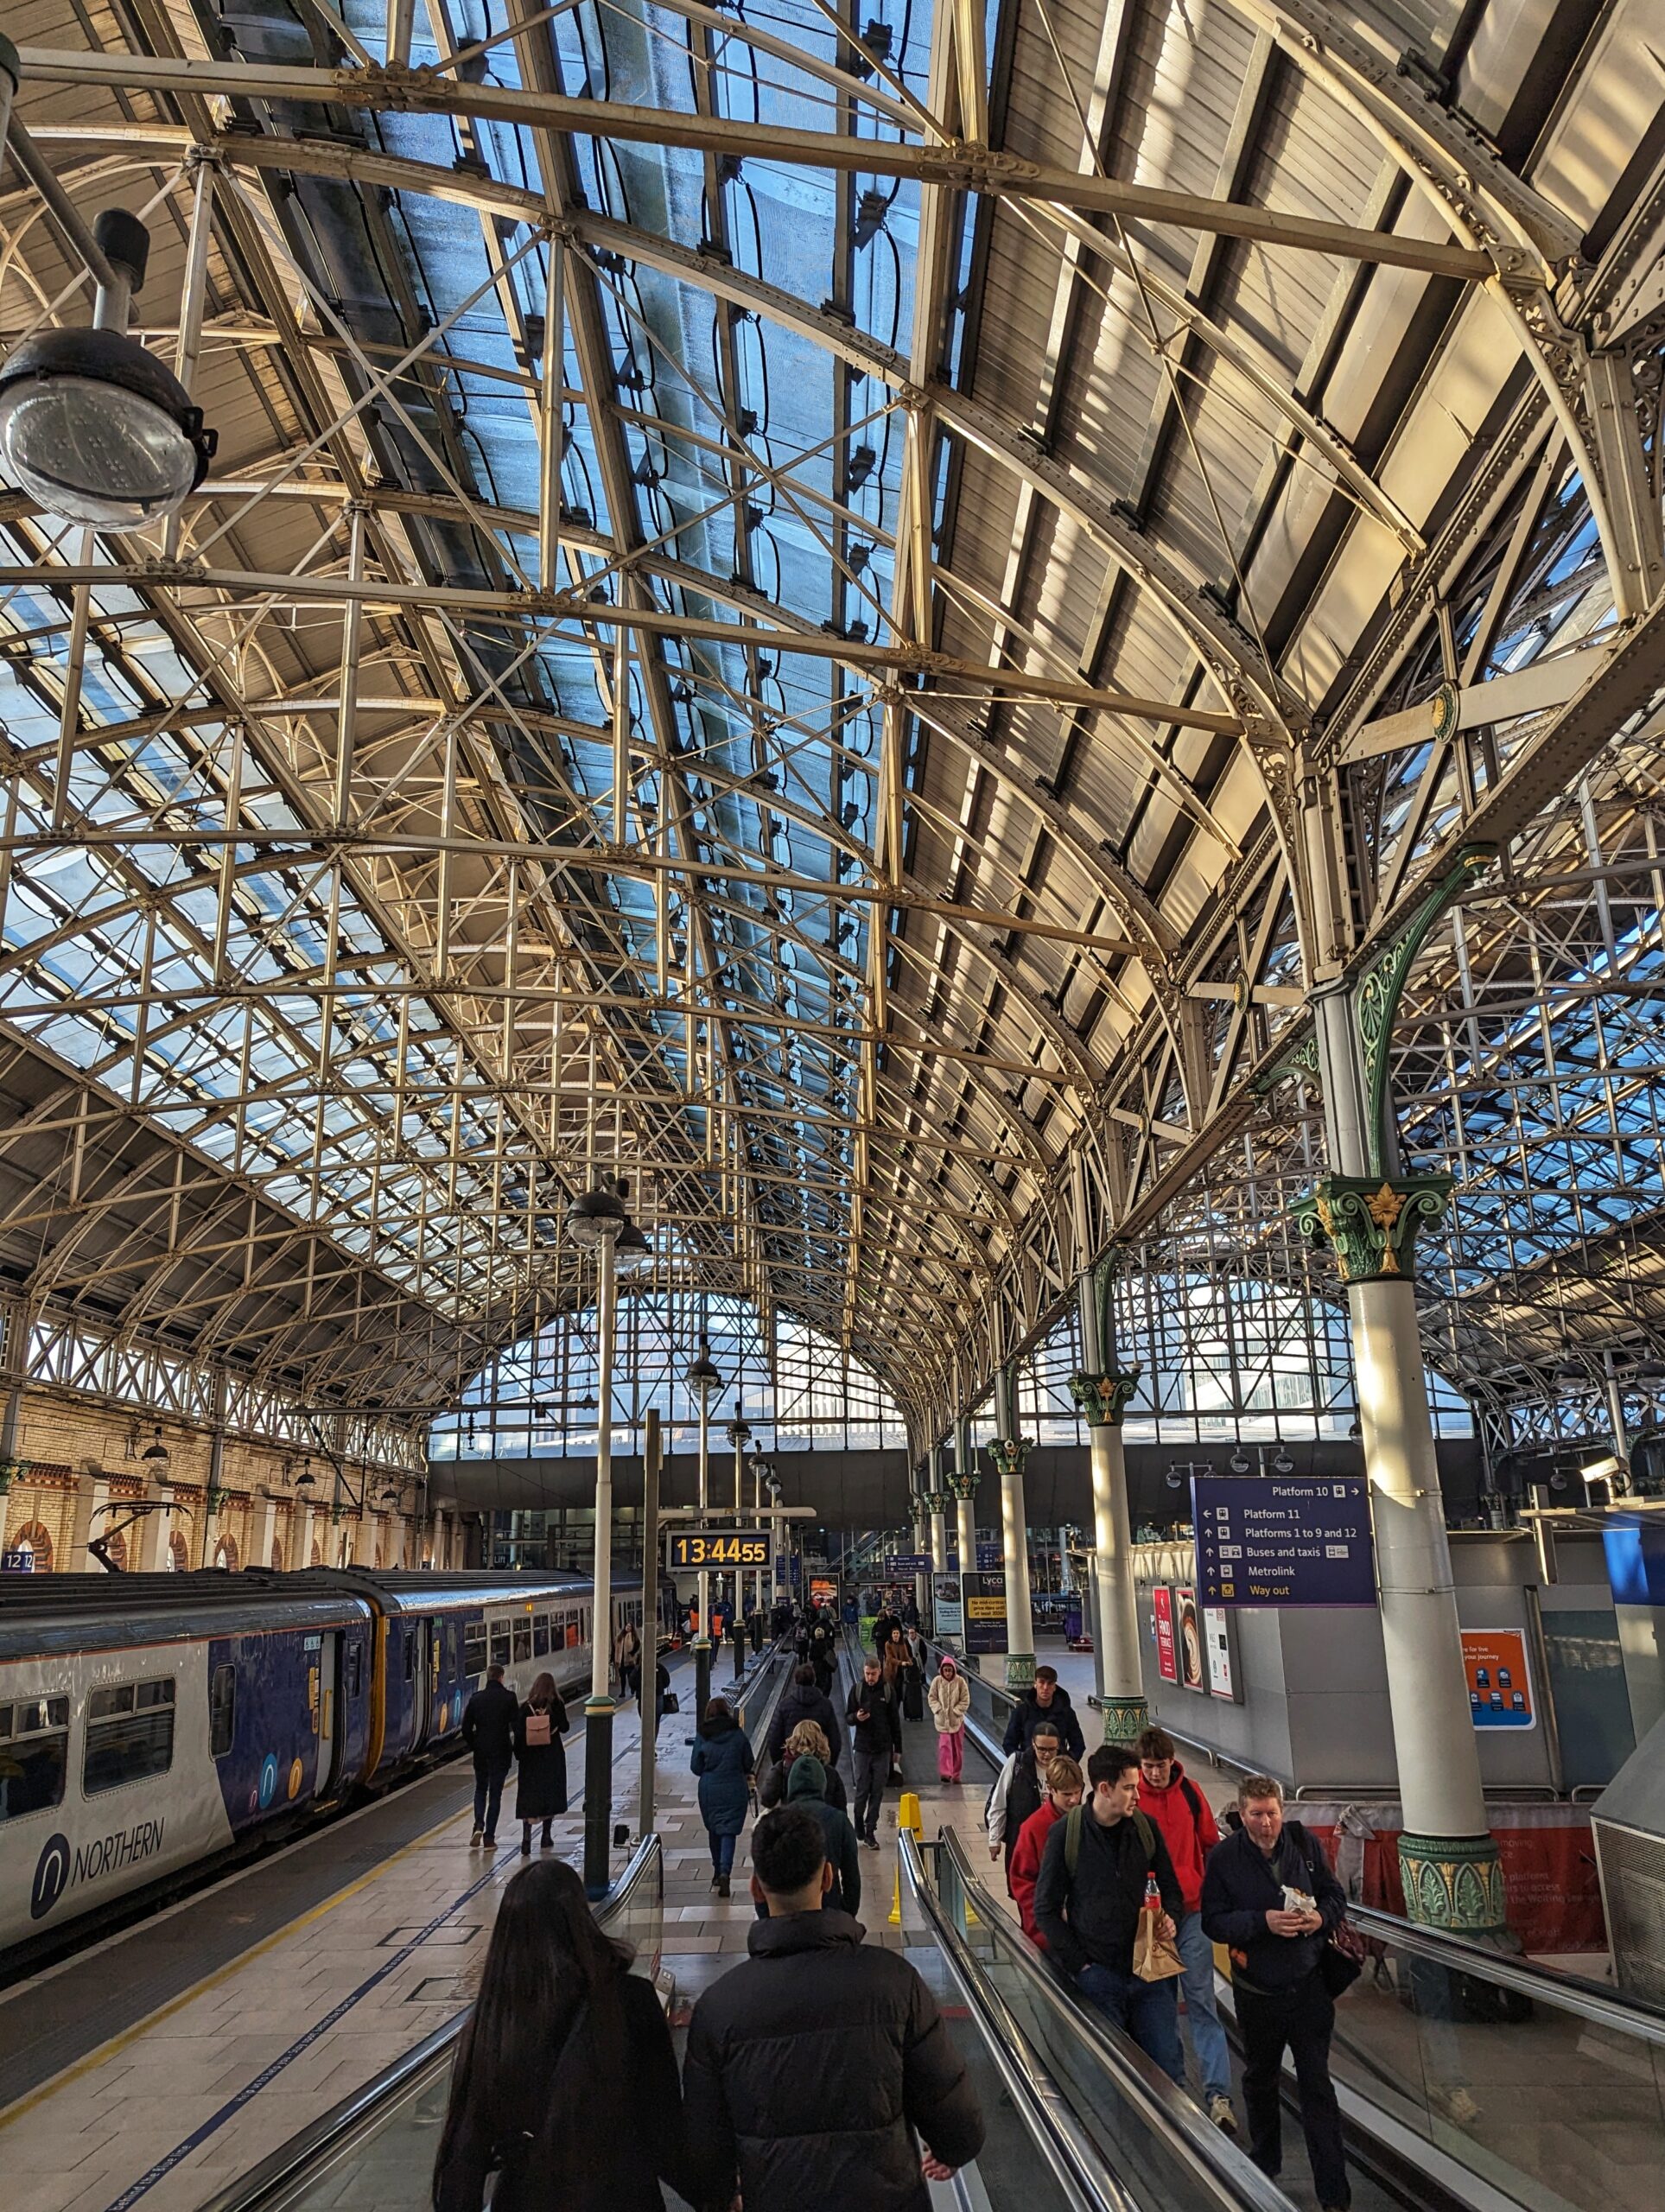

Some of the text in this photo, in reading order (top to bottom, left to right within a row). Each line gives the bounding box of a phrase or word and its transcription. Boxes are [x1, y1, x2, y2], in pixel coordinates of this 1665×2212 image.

[1272, 1486, 1329, 1497] Platform 10
[1243, 1509, 1300, 1519] Platform 11
[1245, 1528, 1292, 1538] Platforms
[1294, 1529, 1300, 1537] 1
[1315, 1529, 1322, 1537] 9
[1324, 1528, 1342, 1537] and
[1344, 1529, 1357, 1538] 12
[1247, 1547, 1321, 1556] Buses and taxis
[7, 1554, 22, 1568] 12
[24, 1554, 33, 1568] 12
[1248, 1566, 1295, 1576] Metrolink
[982, 1576, 1003, 1586] Lyca
[1249, 1585, 1290, 1597] Way out
[1159, 1619, 1170, 1636] FOOD
[71, 1816, 165, 1888] NORTHERN
[233, 2089, 255, 2102] Help
[107, 2145, 192, 2211] behind the Blue line
